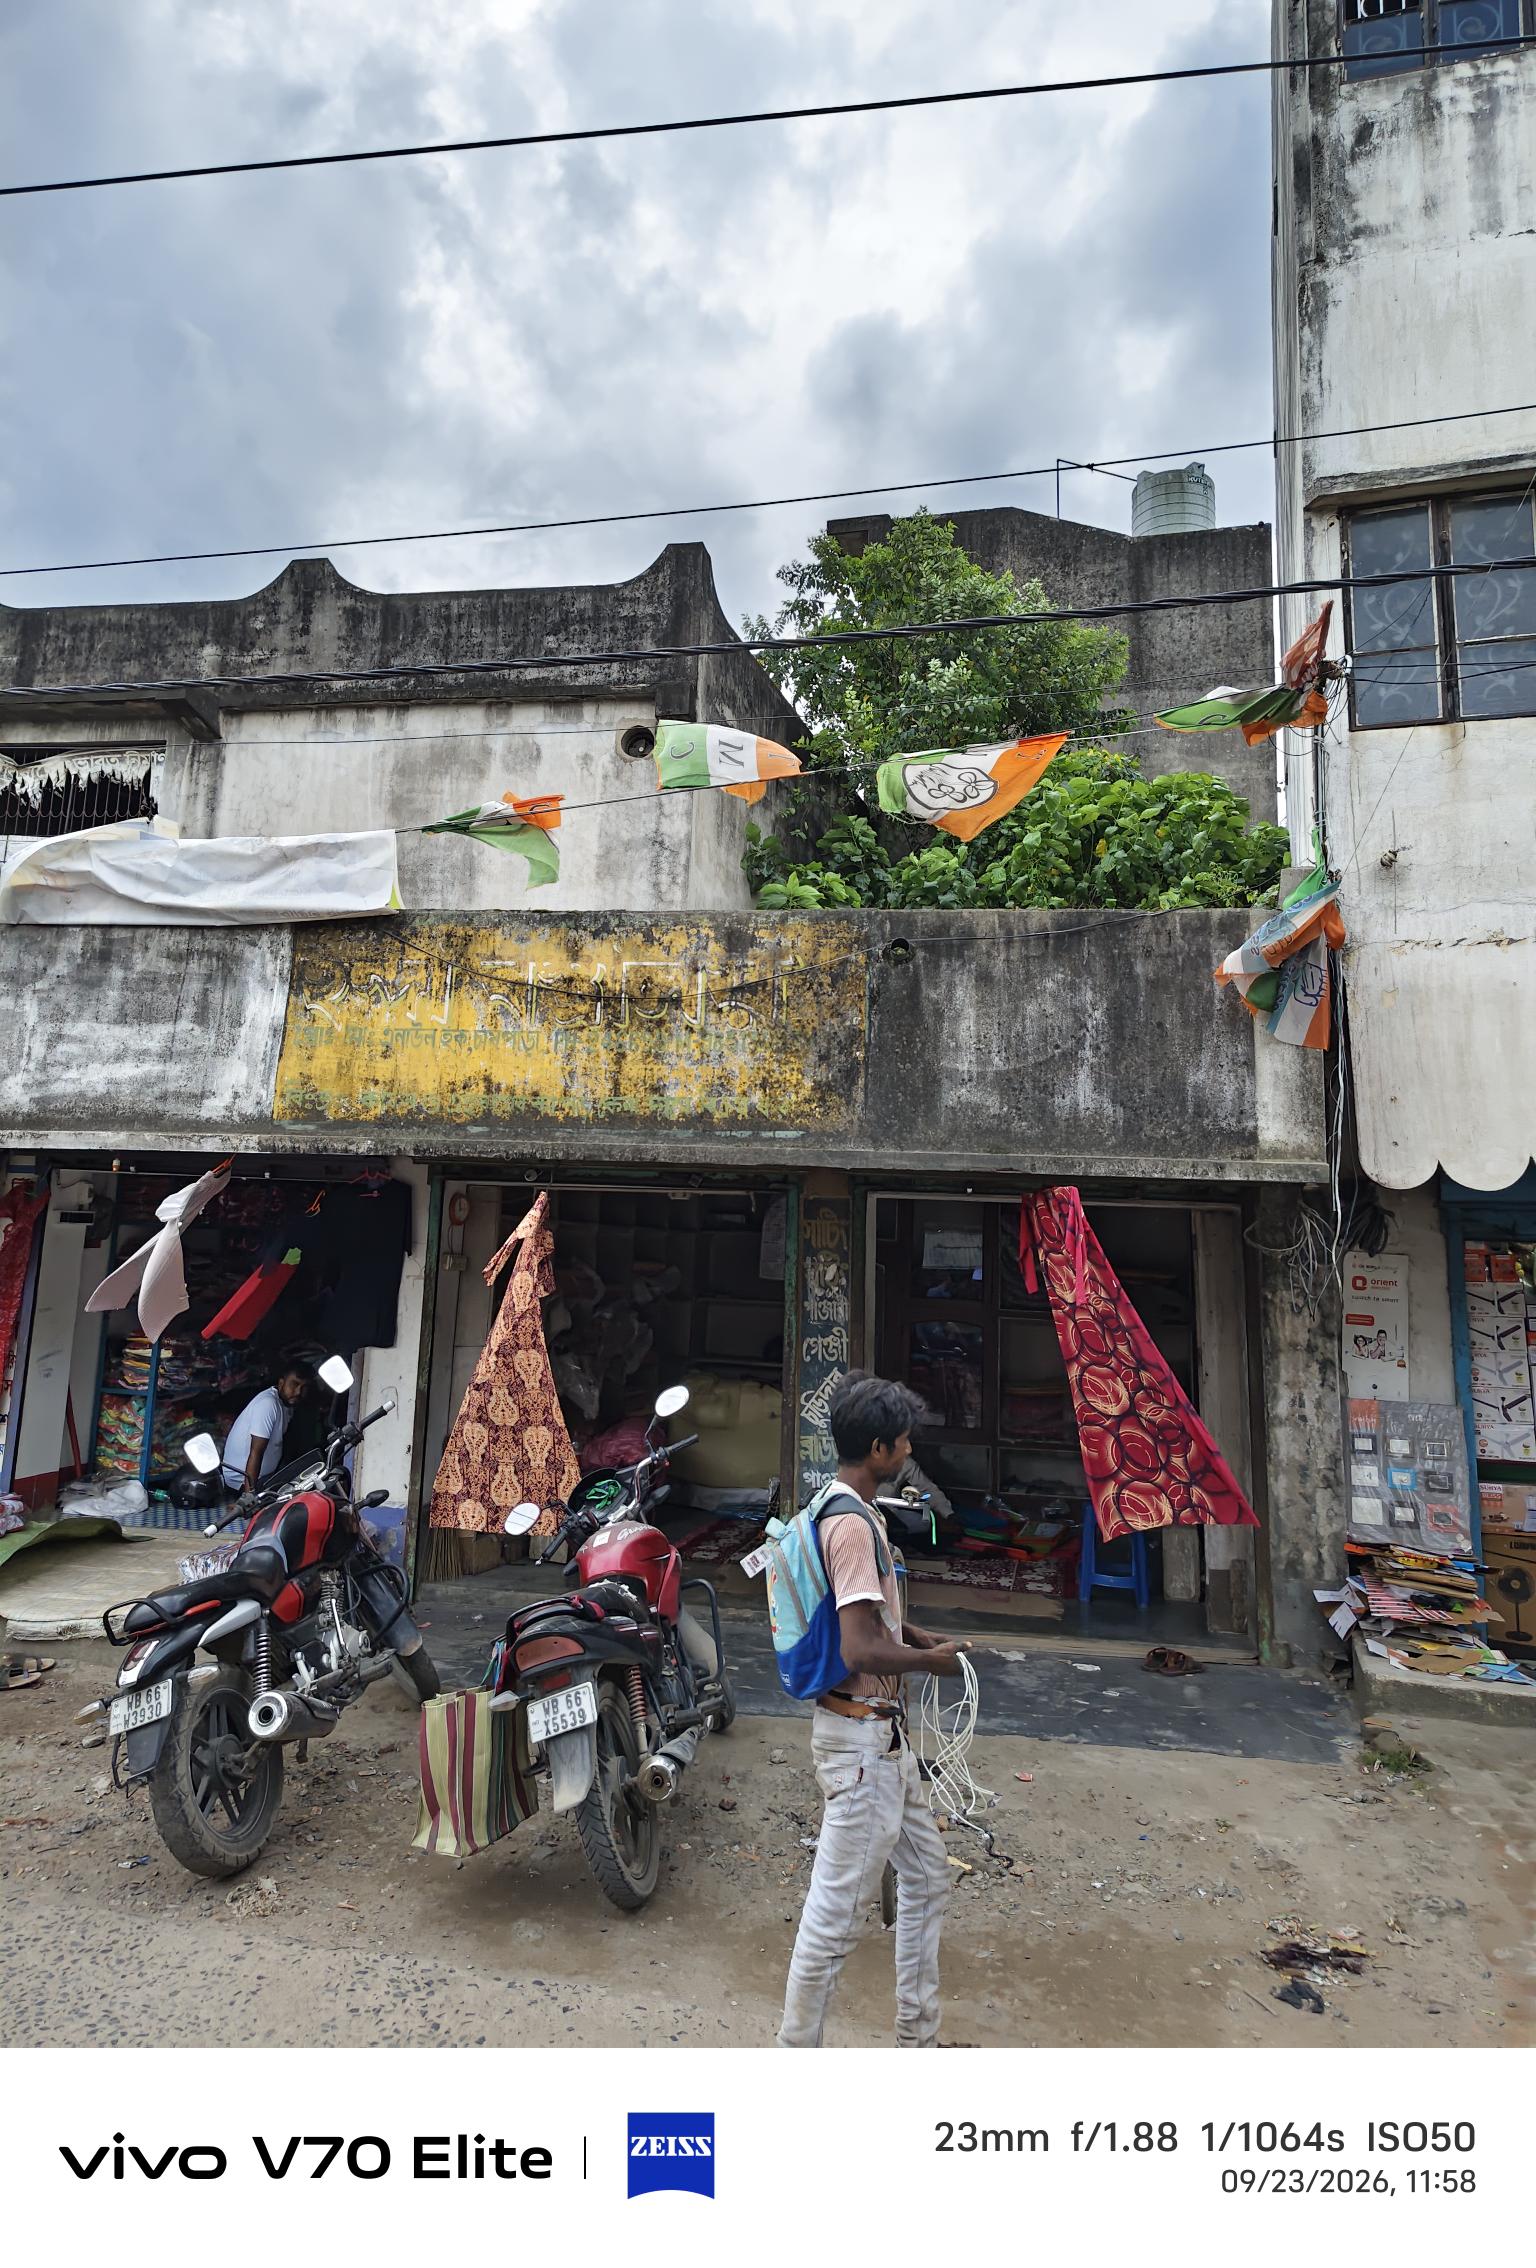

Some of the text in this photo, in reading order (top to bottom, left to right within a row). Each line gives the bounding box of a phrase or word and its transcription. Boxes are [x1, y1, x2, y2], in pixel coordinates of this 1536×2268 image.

[1370, 1277, 1398, 1288] orient
[146, 1685, 161, 1704] 66
[542, 1690, 582, 1719] WB 66
[544, 1707, 587, 1737] X5539
